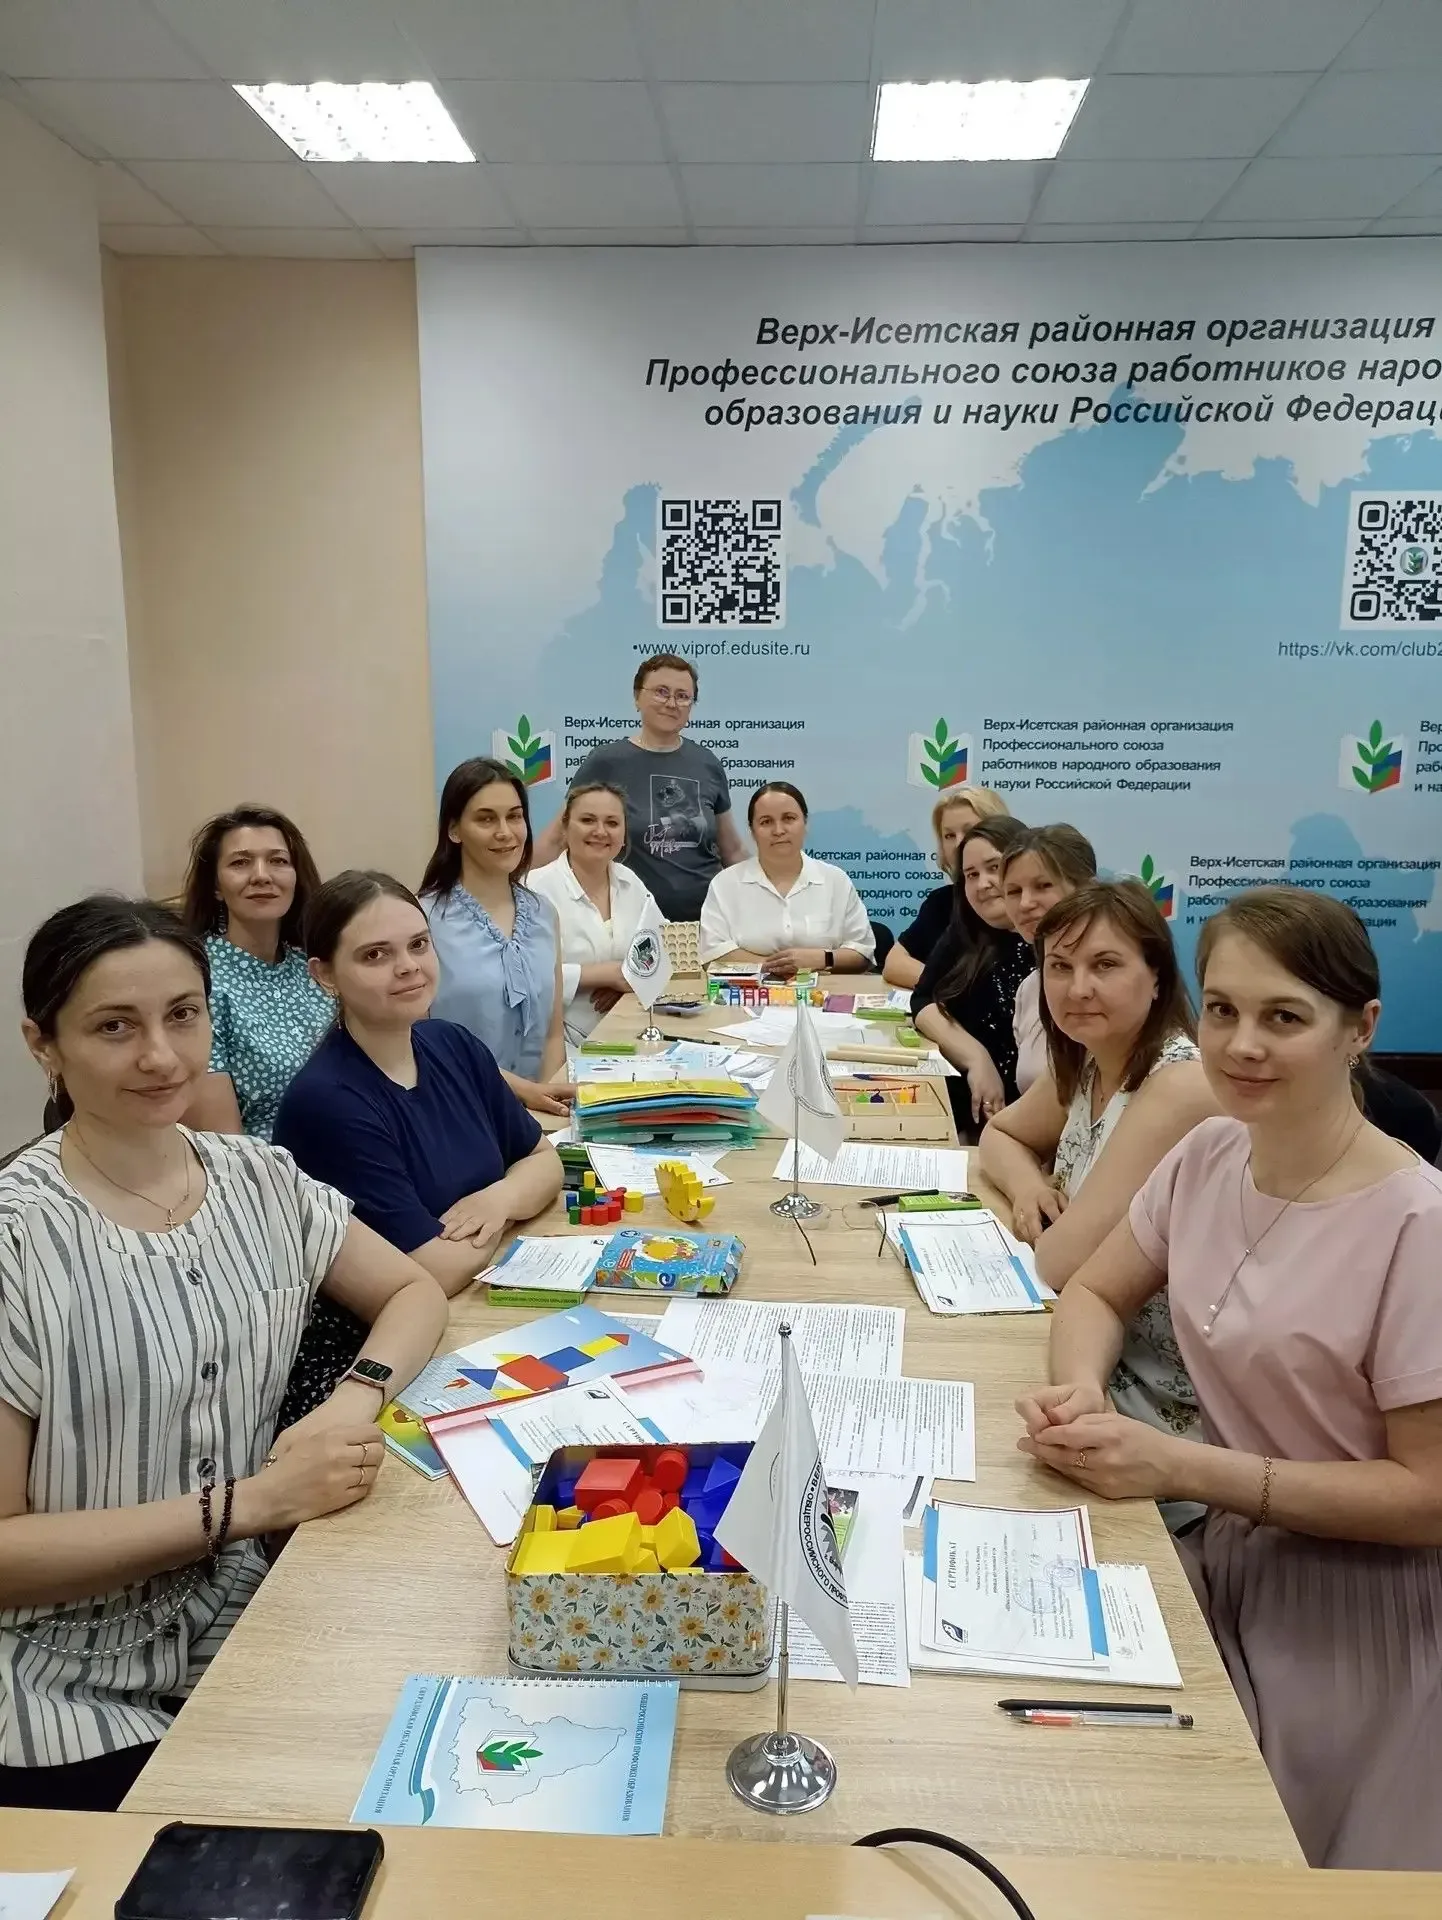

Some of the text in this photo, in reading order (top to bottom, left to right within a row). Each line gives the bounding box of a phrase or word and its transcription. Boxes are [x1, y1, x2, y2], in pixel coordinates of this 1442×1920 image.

[756, 313, 1436, 352] Верх-Исетская районная организация
[645, 358, 1001, 393] Профессионального
[1010, 360, 1118, 384] союза
[1126, 354, 1347, 389] работников
[704, 393, 1442, 432] образования и науки Российской Федерац
[564, 716, 642, 731] Верх-Исетск
[725, 719, 805, 732] организация
[984, 718, 1234, 733] Верх-Исетская районная организация
[700, 739, 739, 748] союза
[983, 738, 1164, 753] Профессионального союза
[721, 755, 795, 769] бразования
[981, 758, 1221, 772] работников народного образования
[981, 778, 1191, 792] и науки Российской Федерации
[1415, 784, 1423, 793] и
[805, 849, 861, 861] Исетская
[865, 849, 926, 863] районная
[1190, 856, 1441, 872] Верх-Исетская районная организация
[905, 871, 944, 880] союза
[1329, 878, 1370, 888] союза
